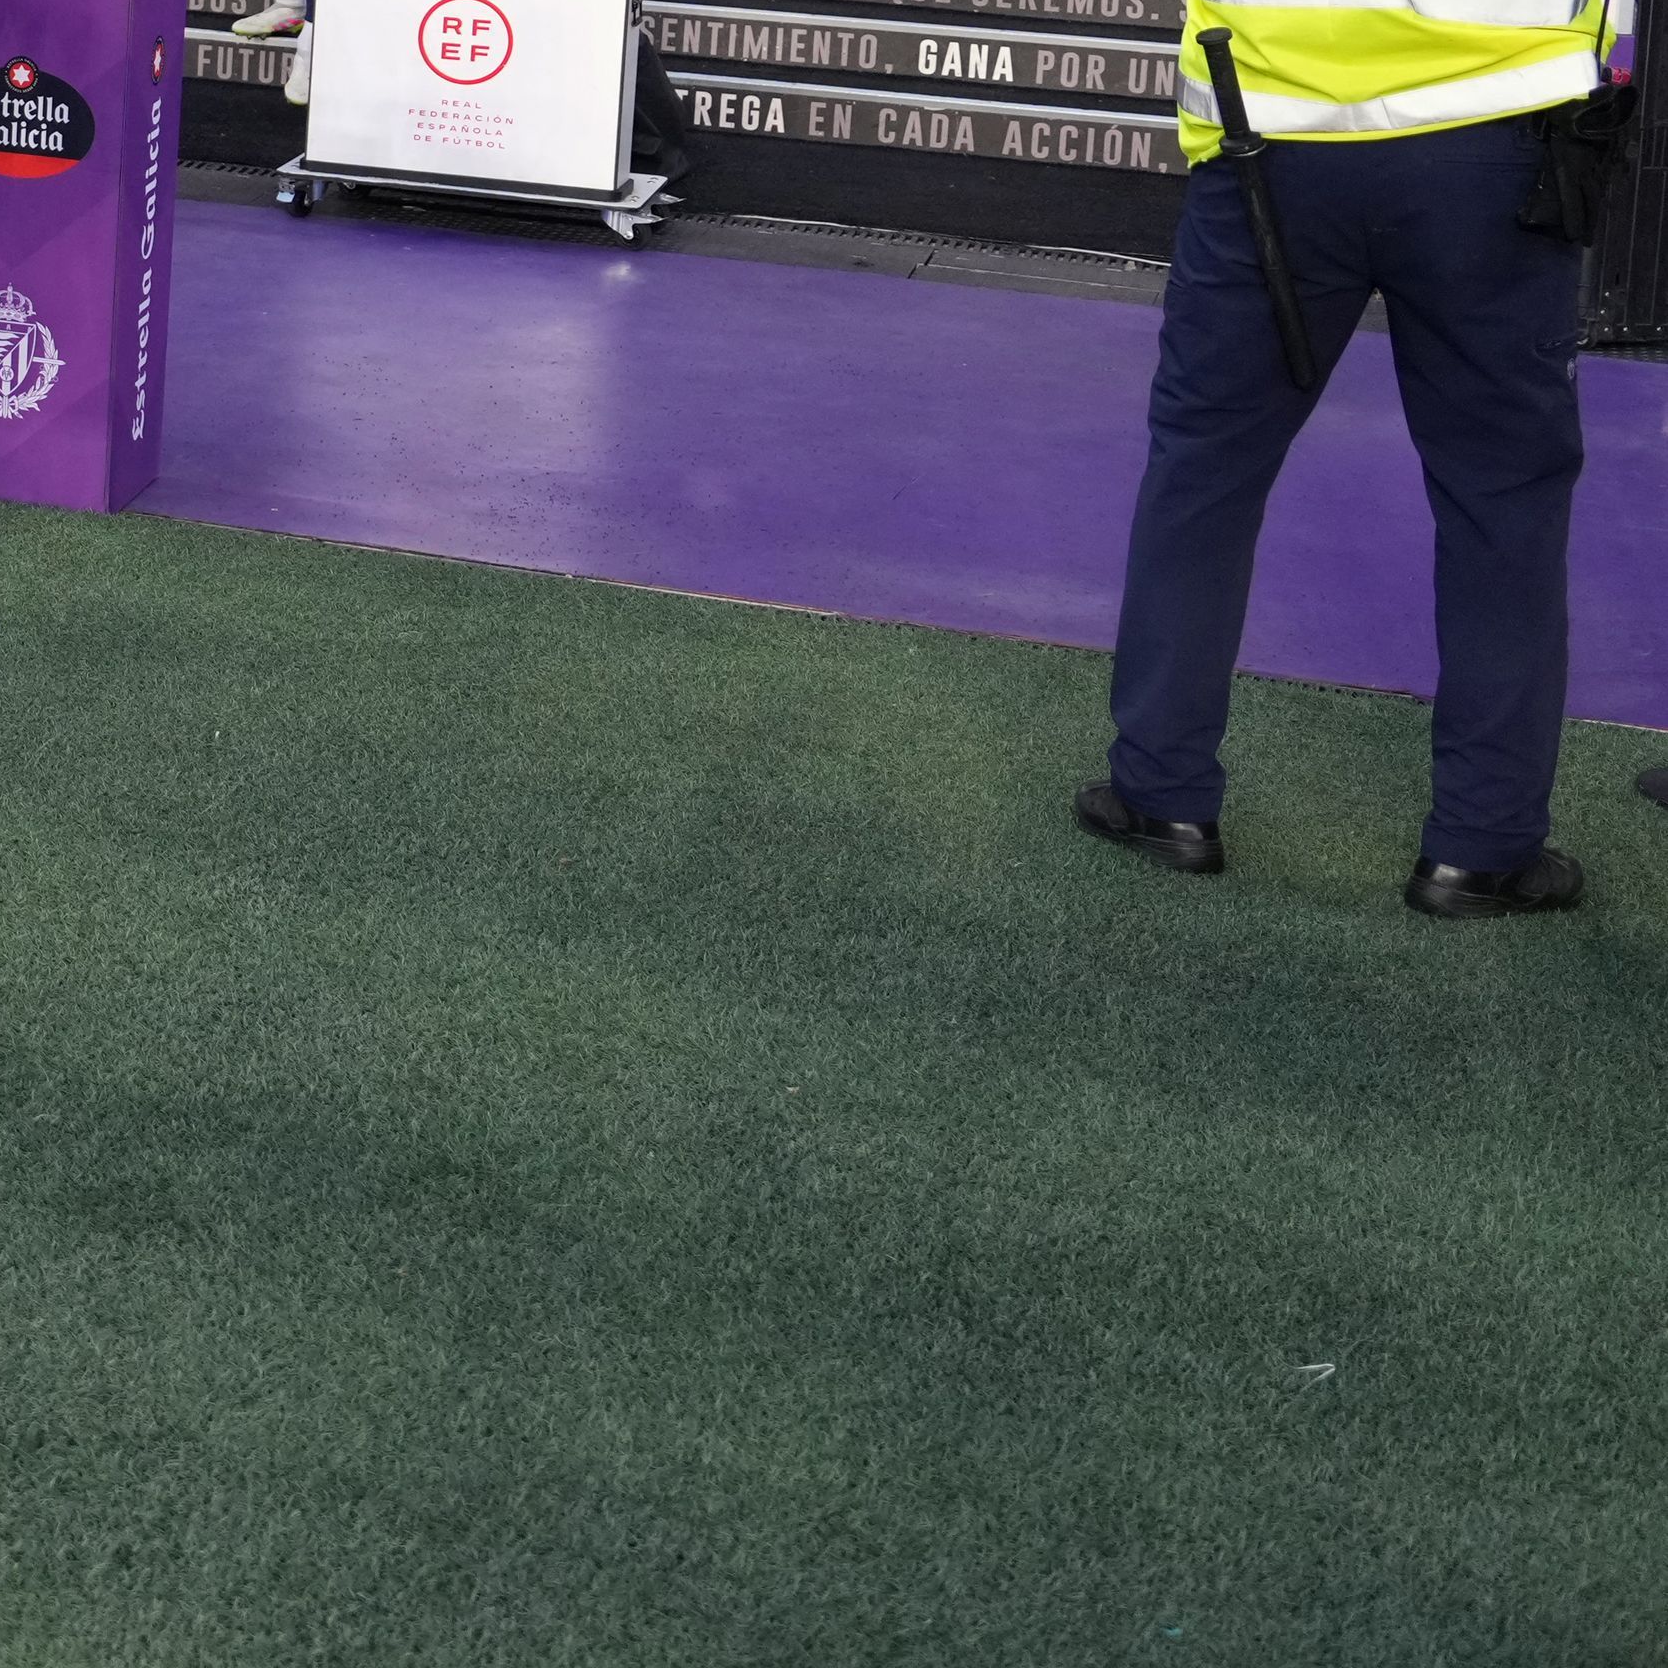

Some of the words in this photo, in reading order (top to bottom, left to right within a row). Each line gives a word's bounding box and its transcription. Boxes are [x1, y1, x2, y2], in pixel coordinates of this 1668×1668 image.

[639, 19, 896, 74] SENTIMIENTO,
[918, 38, 1016, 83] GANA
[1034, 50, 1106, 92] POR
[408, 108, 514, 125] FEDERACIÓN
[441, 99, 482, 109] REAL
[413, 134, 432, 142] DE
[442, 136, 506, 150] FÚTBOL
[417, 122, 503, 136] ESPAÑOLA
[807, 100, 855, 140] EN
[878, 106, 978, 154] CADA
[1000, 116, 1169, 175] ACCIÓN,
[139, 97, 163, 261] Galicia
[130, 267, 153, 442] Estrella
